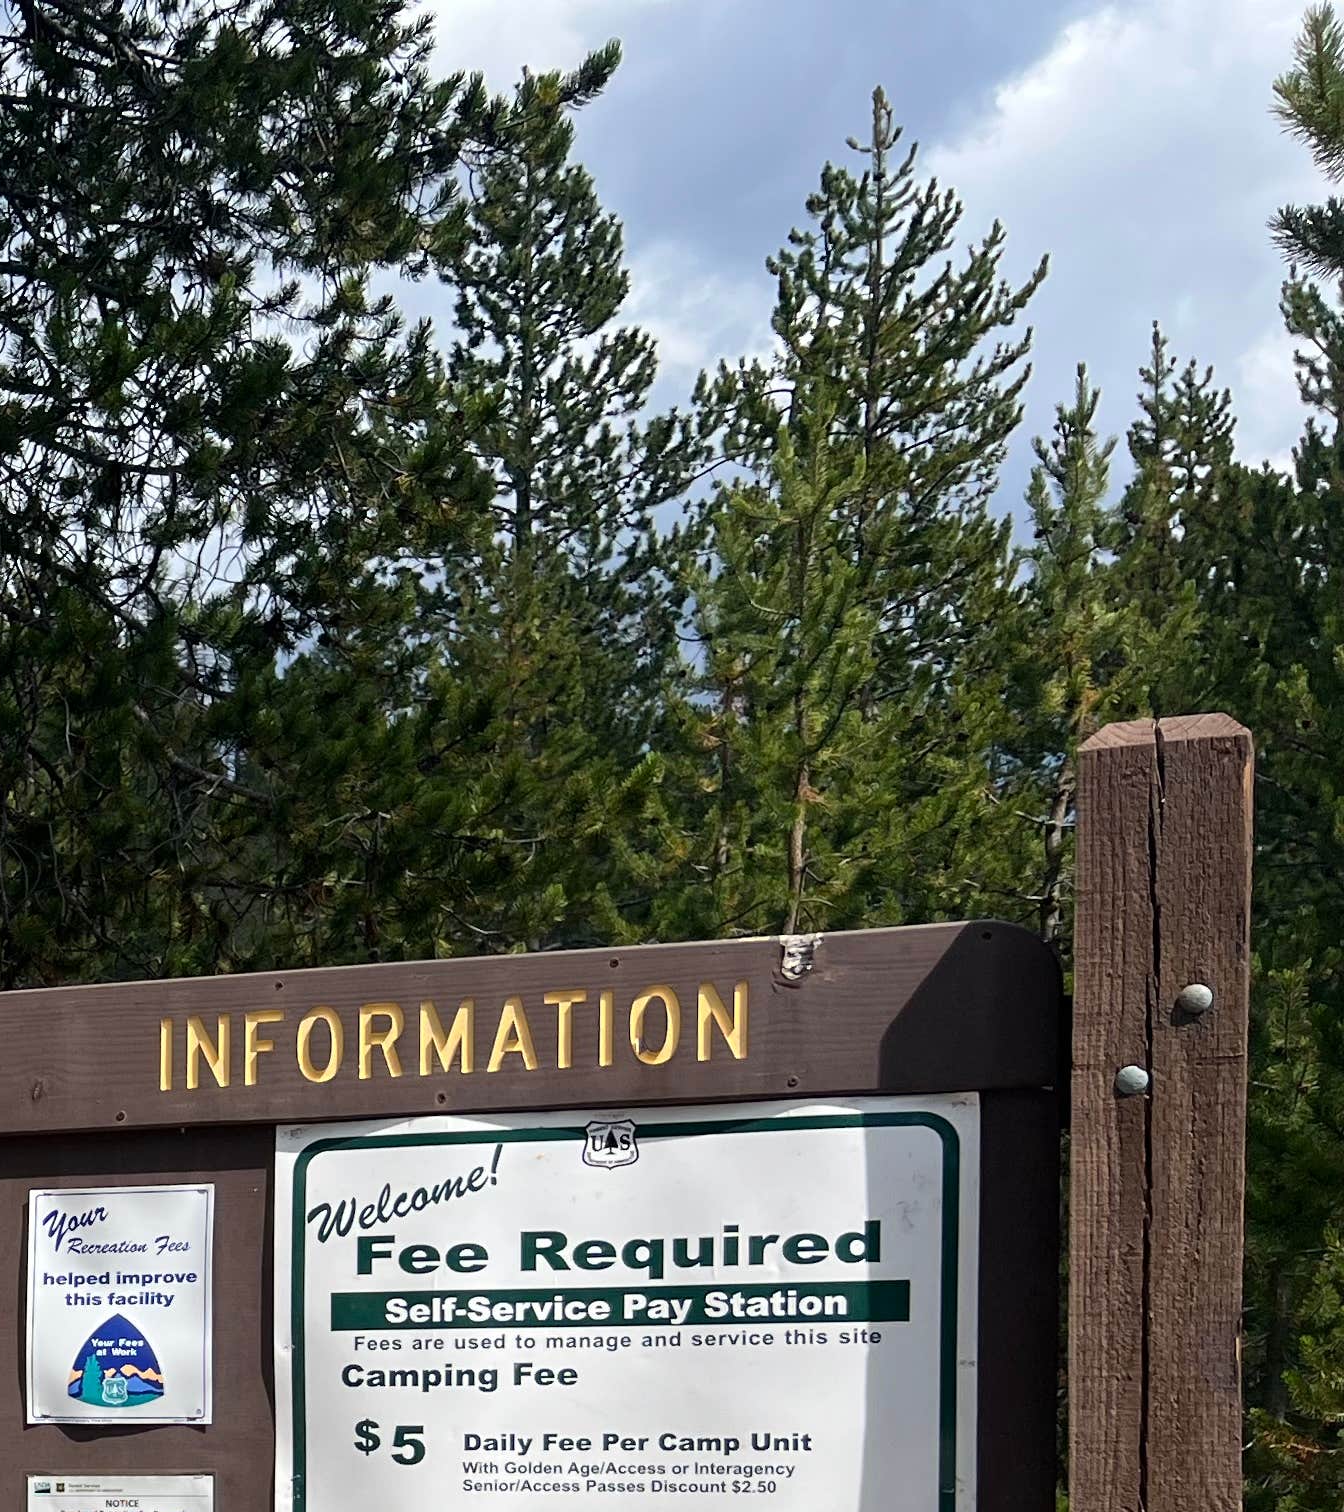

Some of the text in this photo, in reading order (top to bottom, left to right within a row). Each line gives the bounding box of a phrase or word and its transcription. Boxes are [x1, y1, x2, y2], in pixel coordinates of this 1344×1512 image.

[159, 979, 749, 1092] INFORMATION
[307, 1144, 503, 1243] Welcome!
[42, 1206, 109, 1252] Your
[67, 1235, 191, 1255] Recreation Fees
[356, 1221, 882, 1280] Fee Required
[43, 1271, 198, 1288] helped improve
[65, 1292, 175, 1307] this facility
[385, 1291, 848, 1325] Self-Service Pay Station
[91, 1338, 144, 1347] Your Fees
[354, 1328, 882, 1350] Fees are used to manage and service this site
[96, 1348, 137, 1356] at Work
[341, 1362, 577, 1392] Camping Fee
[464, 1433, 811, 1455] Daily Fee Per Camp Unit
[462, 1462, 795, 1477] With Golden Age/Access or Interagency
[462, 1479, 776, 1493] Senior/Access Passes Discount $2.50
[105, 1500, 139, 1508] NOTICE
